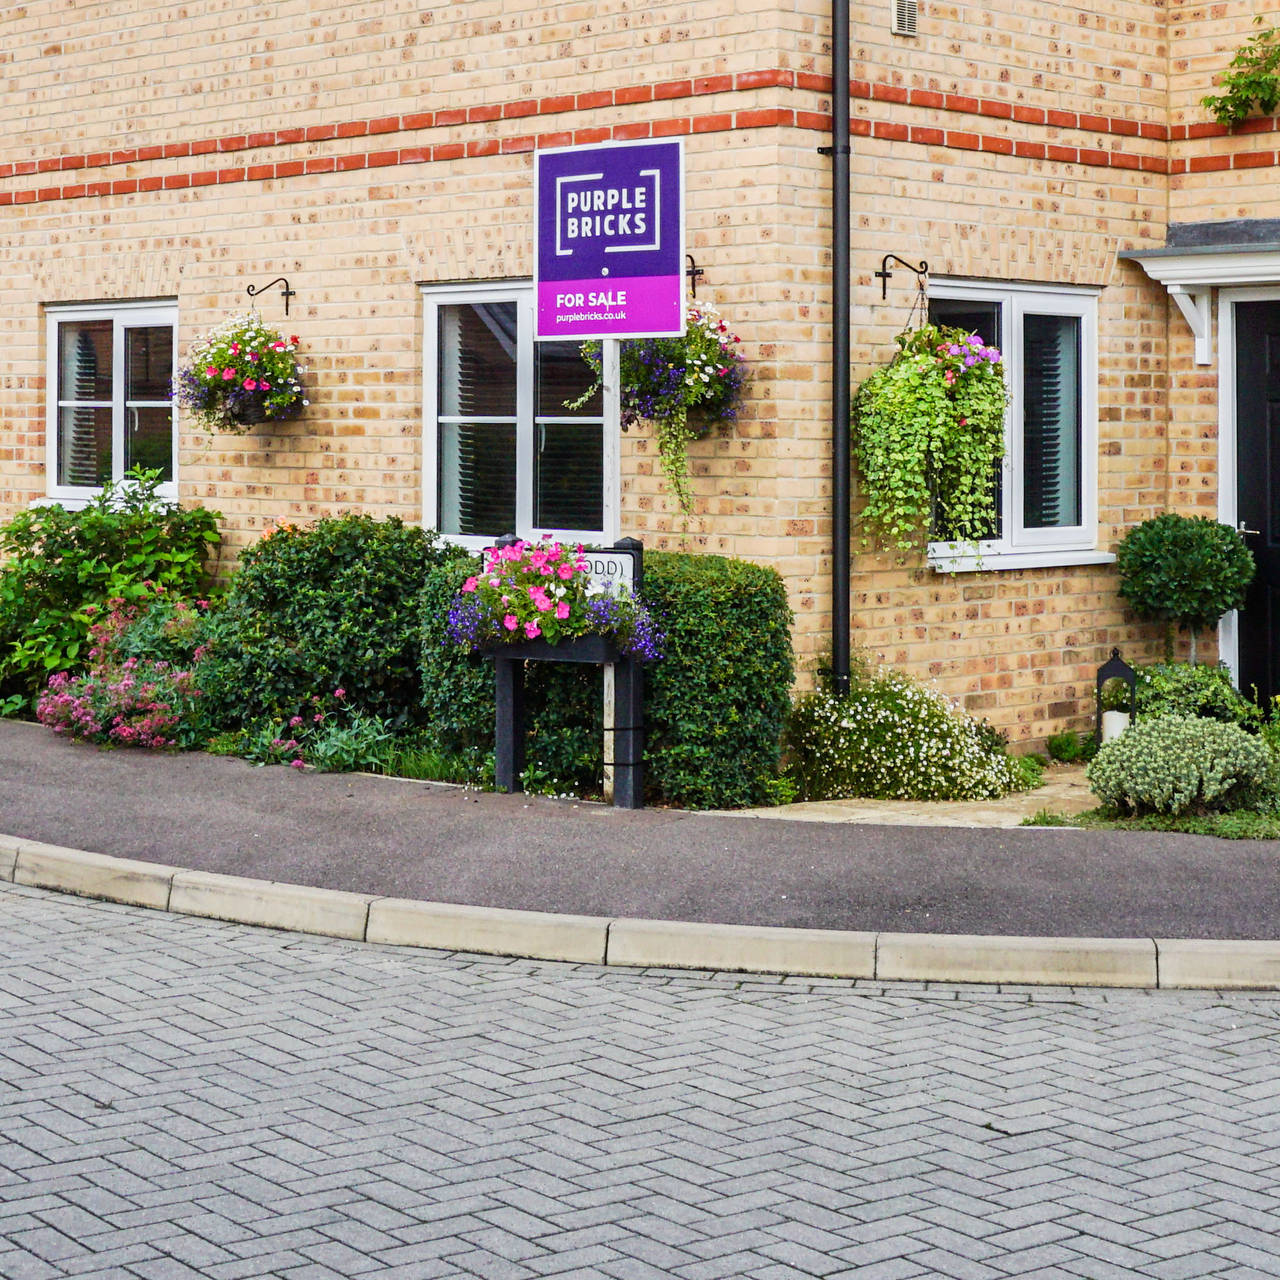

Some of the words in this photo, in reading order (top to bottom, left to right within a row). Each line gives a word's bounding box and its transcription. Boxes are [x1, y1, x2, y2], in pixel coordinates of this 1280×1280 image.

[567, 187, 646, 213] PURPLE
[567, 213, 647, 238] BRICKS
[556, 293, 585, 308] FOR
[588, 291, 627, 306] SALE
[556, 311, 627, 323] purplebricks.co.uk
